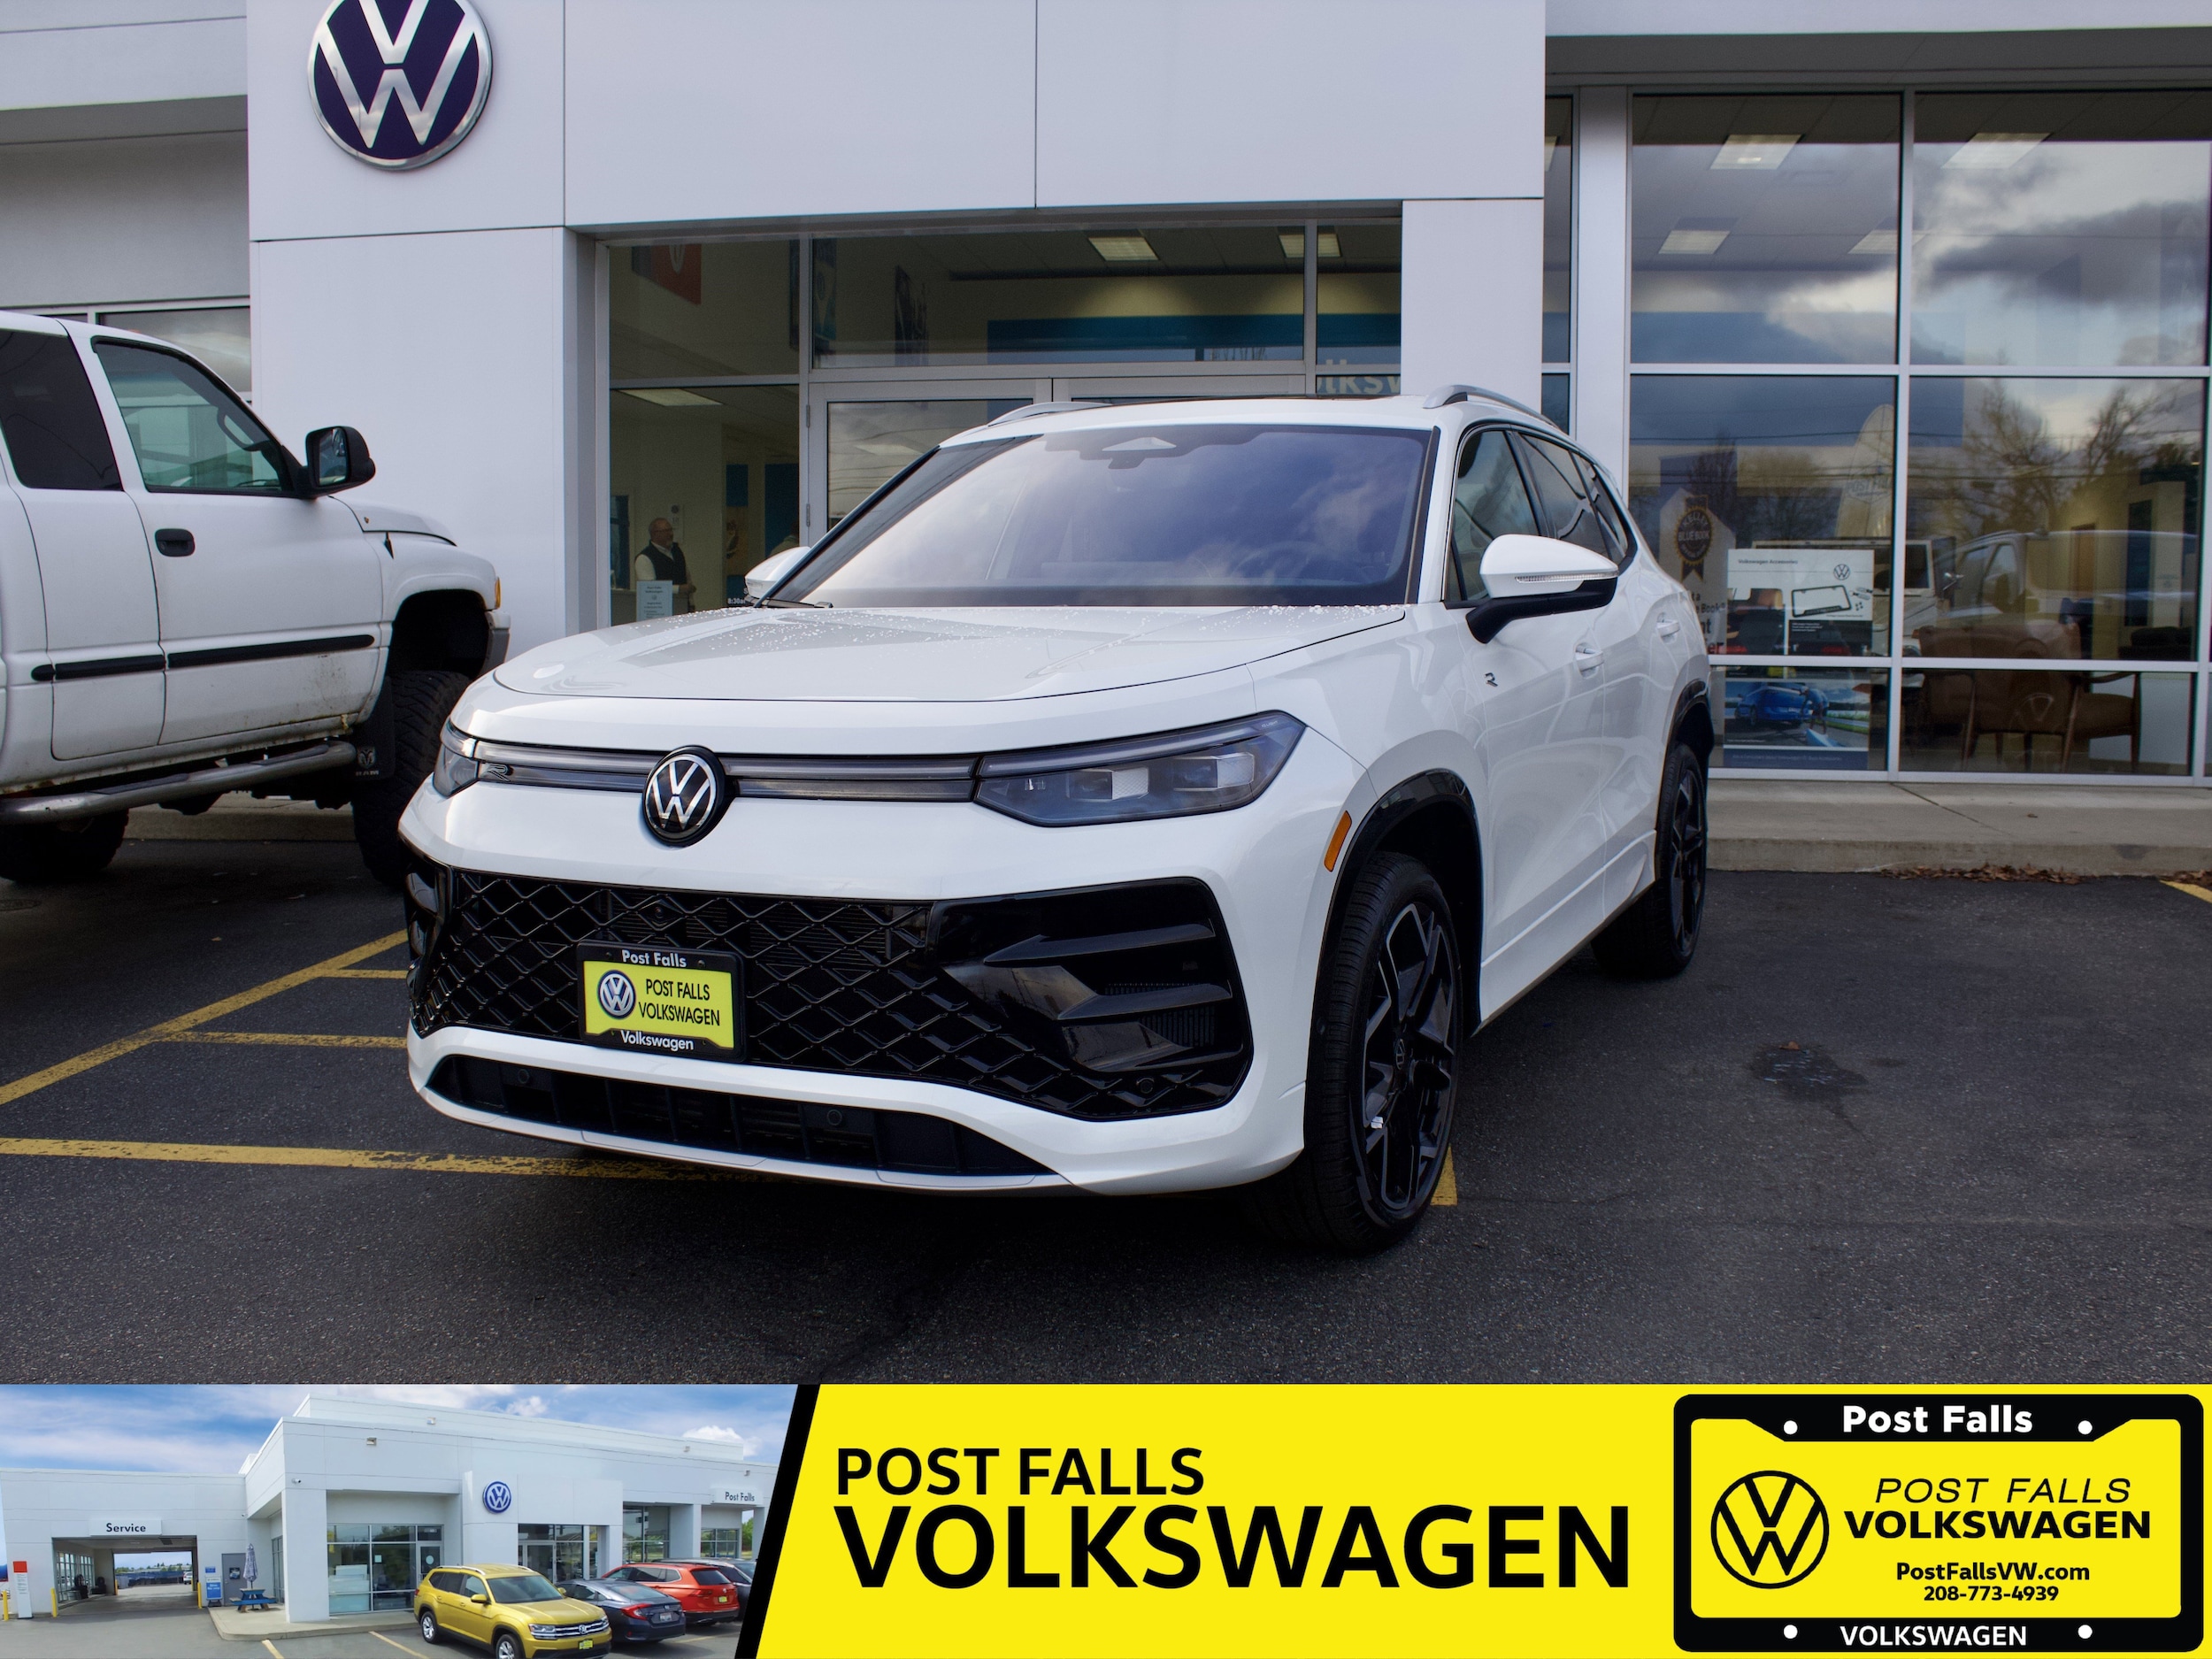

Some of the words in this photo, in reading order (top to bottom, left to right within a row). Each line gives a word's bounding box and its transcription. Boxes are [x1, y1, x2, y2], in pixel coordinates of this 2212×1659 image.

[621, 949, 650, 964] Post
[653, 952, 687, 968] Falls
[646, 979, 673, 996] POST
[678, 982, 710, 1001] FALLS
[639, 1002, 720, 1026] VOLKSWAGEN
[620, 1030, 695, 1052] Volkswagen
